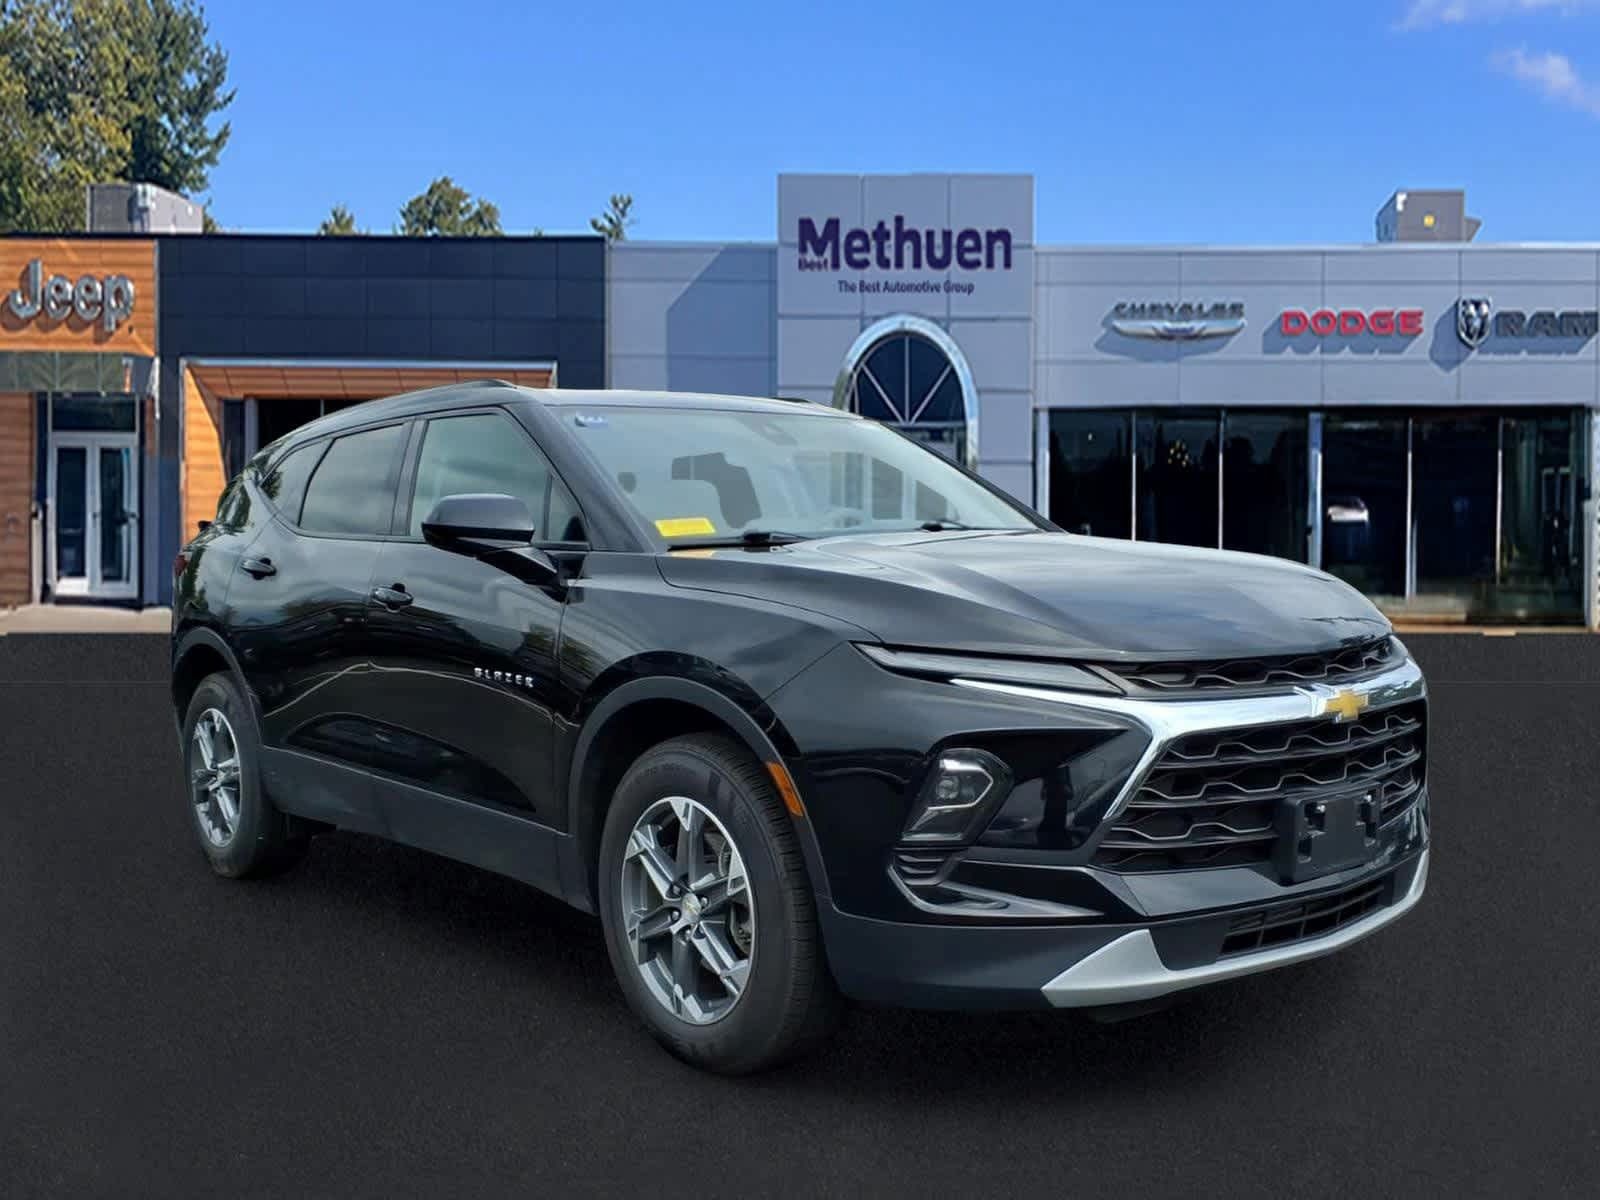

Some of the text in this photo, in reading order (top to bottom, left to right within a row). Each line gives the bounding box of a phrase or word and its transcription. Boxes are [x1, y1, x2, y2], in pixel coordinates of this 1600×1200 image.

[798, 215, 1012, 270] Methuen
[9, 259, 134, 332] Jeep
[838, 280, 975, 295] The Best Automotive Group
[1281, 309, 1424, 335] DODGE
[1495, 311, 1599, 337] RAM
[474, 667, 534, 688] BLAZER
